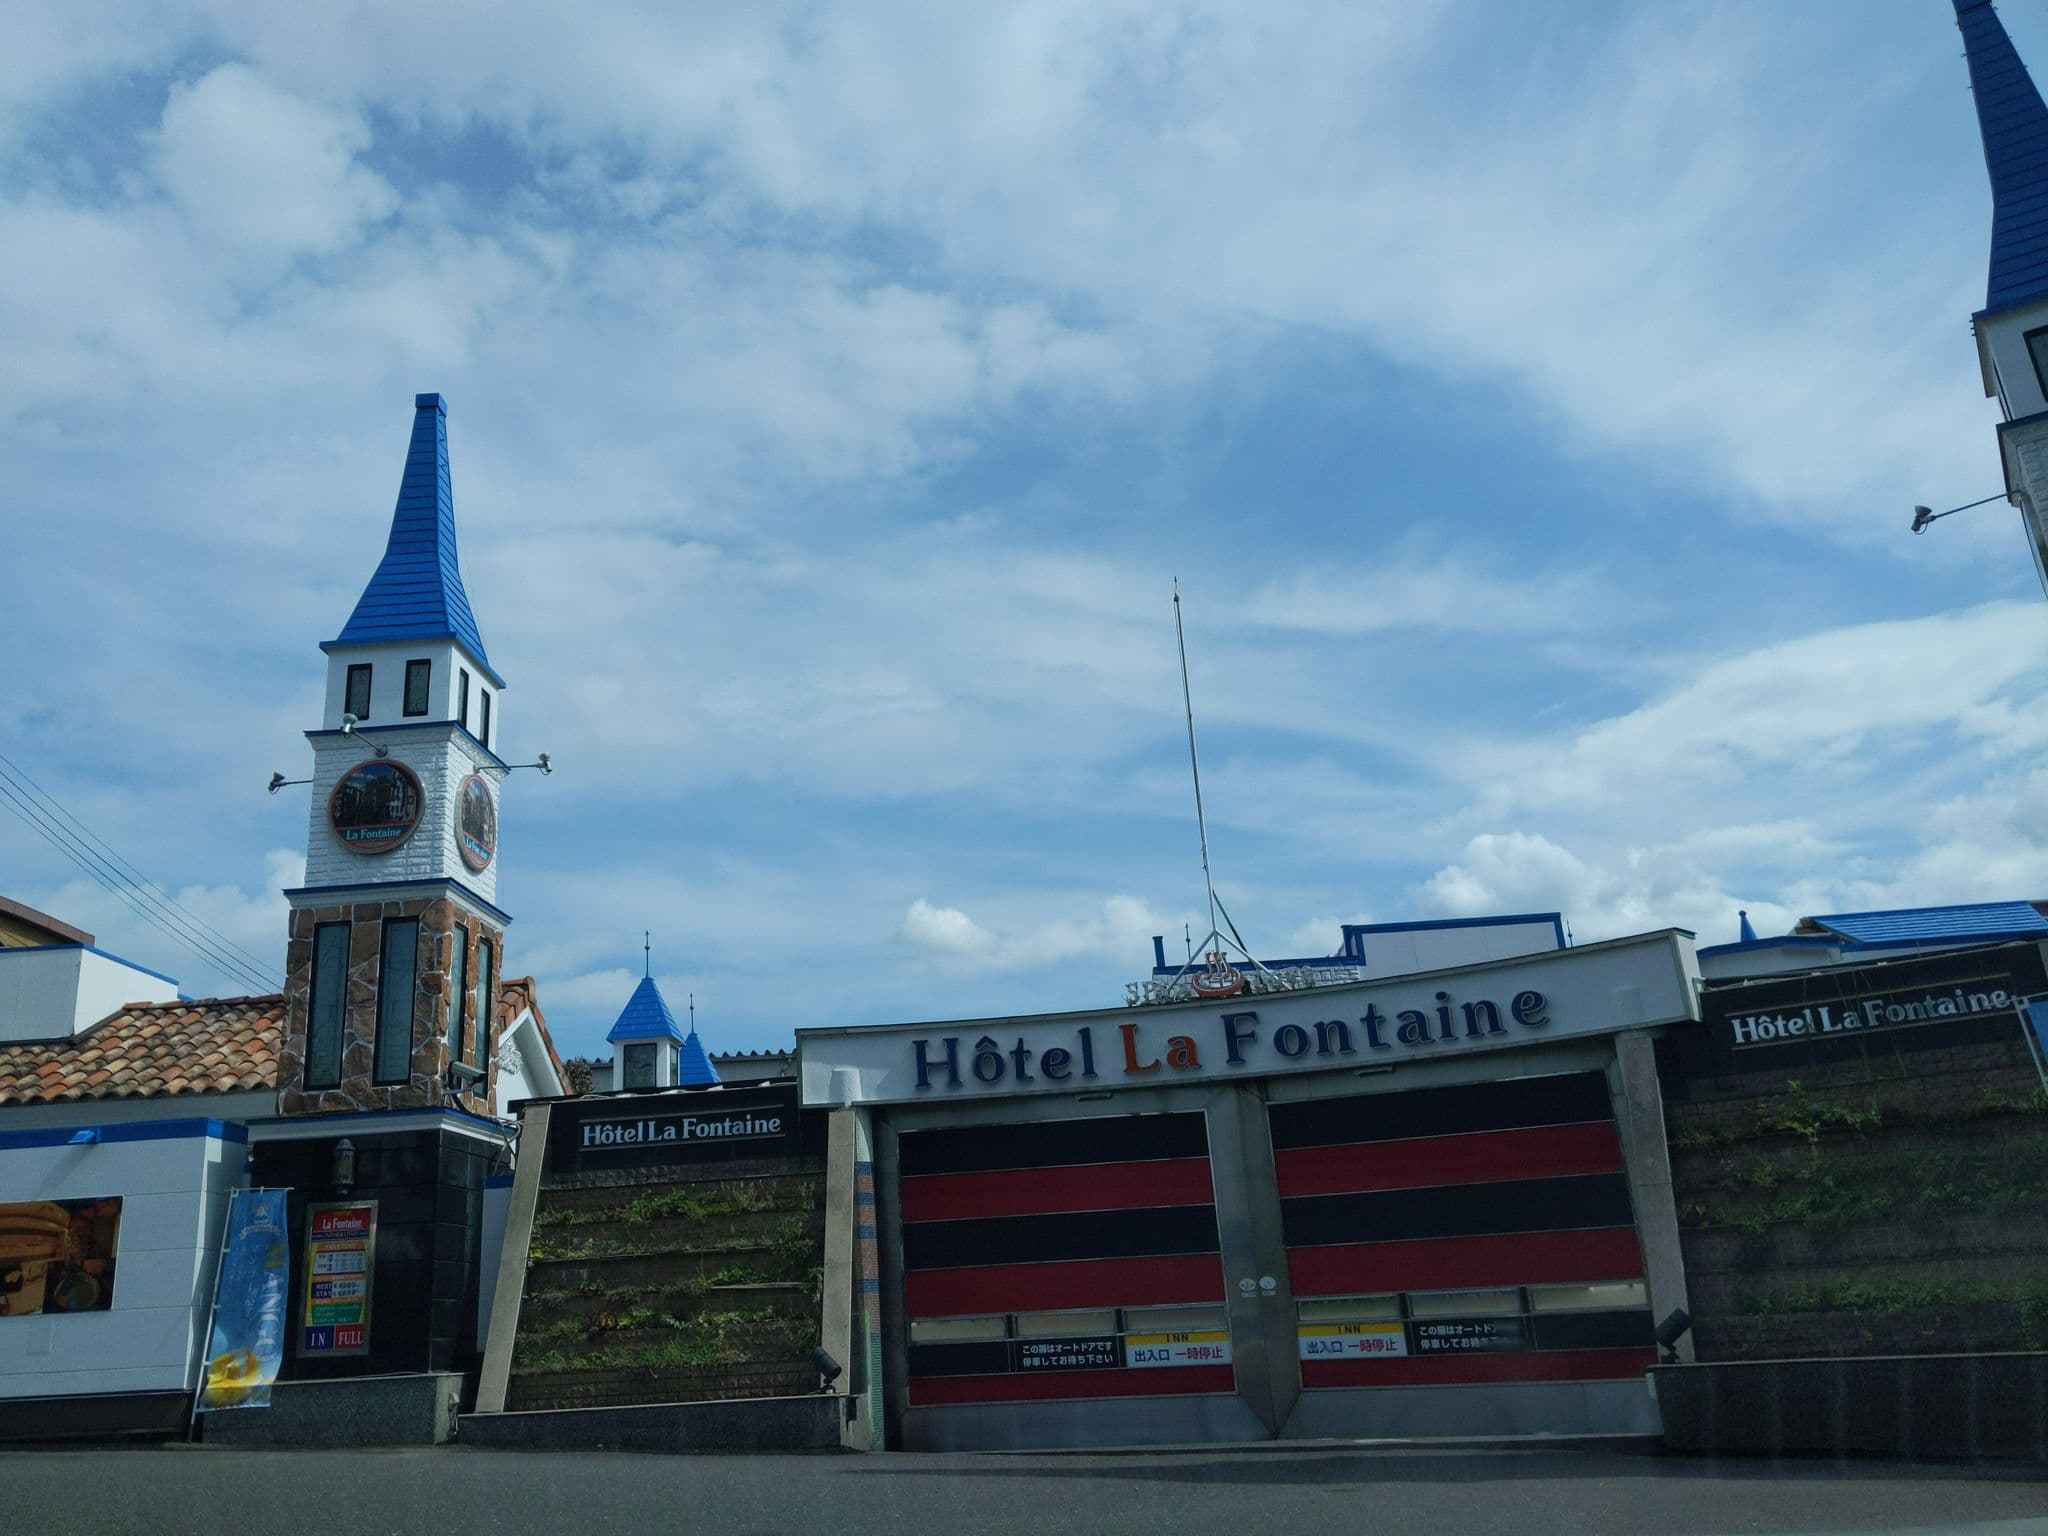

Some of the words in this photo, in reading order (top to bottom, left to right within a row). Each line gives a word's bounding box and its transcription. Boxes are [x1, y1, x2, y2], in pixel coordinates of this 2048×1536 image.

[346, 830, 358, 841] La
[361, 828, 401, 840] Fontaine
[1731, 1008, 1816, 1044] Hôtel
[1818, 1006, 1863, 1033] La
[1863, 988, 2011, 1027] Fontaine
[911, 1026, 1098, 1089] Hôtel
[1118, 1023, 1202, 1074] La
[1220, 990, 1550, 1066] Fontaine
[583, 1121, 644, 1146] Hôtel
[648, 1120, 676, 1142] La
[682, 1114, 781, 1140] Fontaine
[322, 1218, 331, 1230] La
[333, 1217, 362, 1229] Fontaine
[254, 1242, 287, 1361] MANGO
[1338, 1325, 1361, 1335] INN
[311, 1332, 325, 1346] IN
[338, 1331, 363, 1345] FULL
[1166, 1333, 1189, 1343] INN
[1307, 1341, 1343, 1354] 出入口
[1348, 1338, 1397, 1353] 一時停止
[1134, 1349, 1169, 1362] 出入口
[1175, 1346, 1224, 1360] 一時停止
